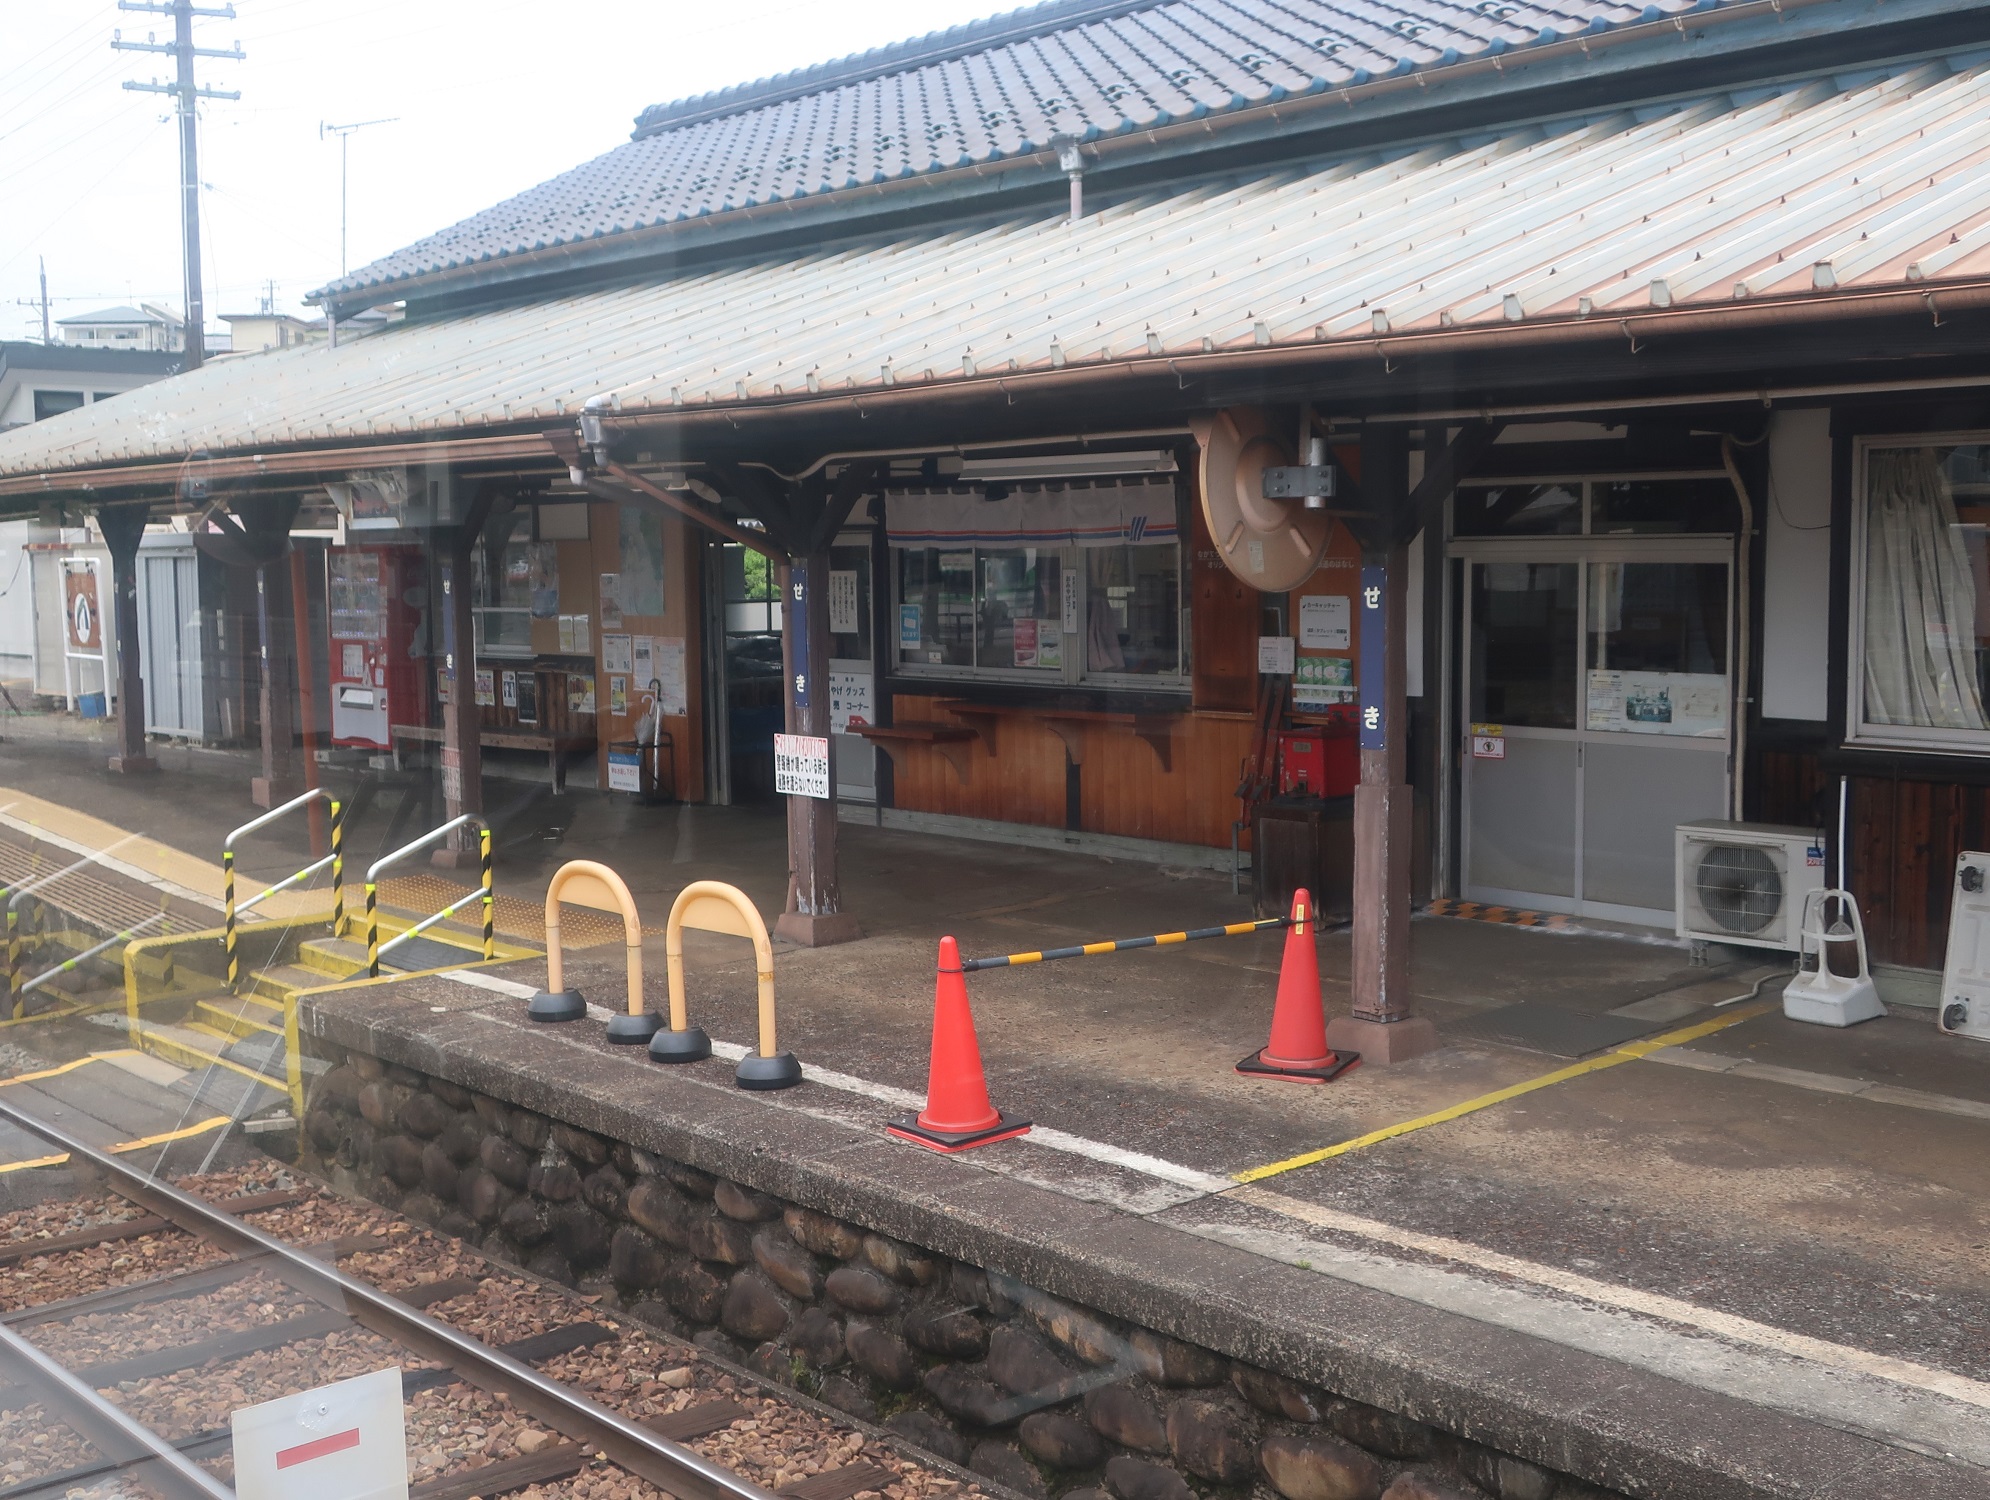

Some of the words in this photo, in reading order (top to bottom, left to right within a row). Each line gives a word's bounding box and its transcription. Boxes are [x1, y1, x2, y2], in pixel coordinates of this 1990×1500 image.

[845, 686, 866, 697] グッズ
[846, 702, 869, 711] コーナー
